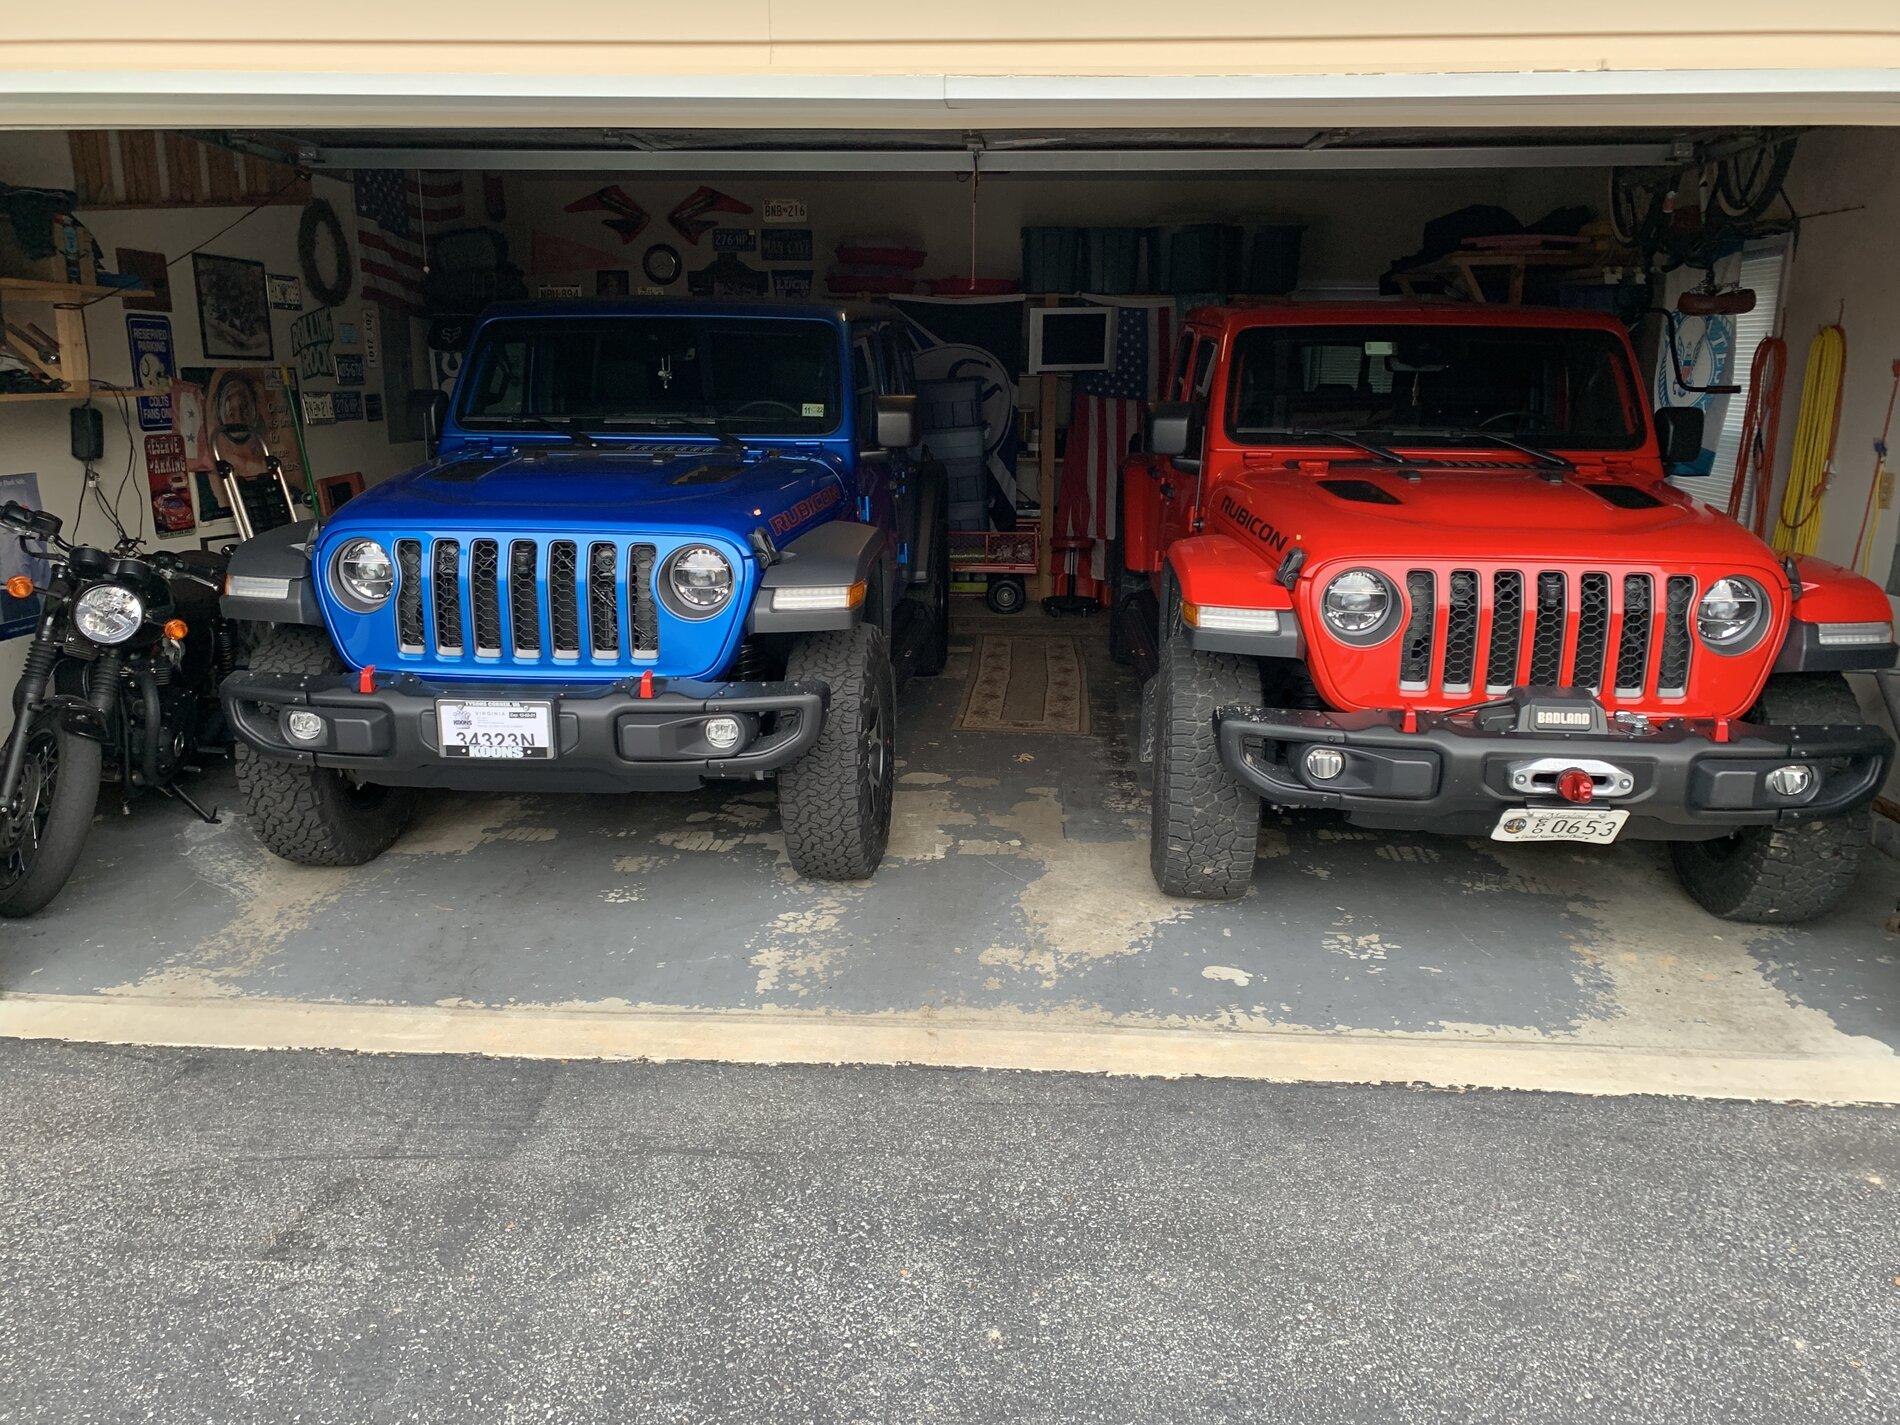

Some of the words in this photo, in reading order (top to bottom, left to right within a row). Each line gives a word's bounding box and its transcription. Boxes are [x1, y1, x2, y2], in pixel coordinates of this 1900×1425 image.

[788, 205, 805, 217] 216
[149, 396, 169, 407] COLTS
[769, 484, 840, 536] RUBICON
[1221, 496, 1289, 552] RUBICON
[1537, 712, 1591, 725] BADLAND
[456, 732, 535, 747] 34323N
[469, 746, 524, 758] KOONS
[1551, 820, 1617, 836] 0653
